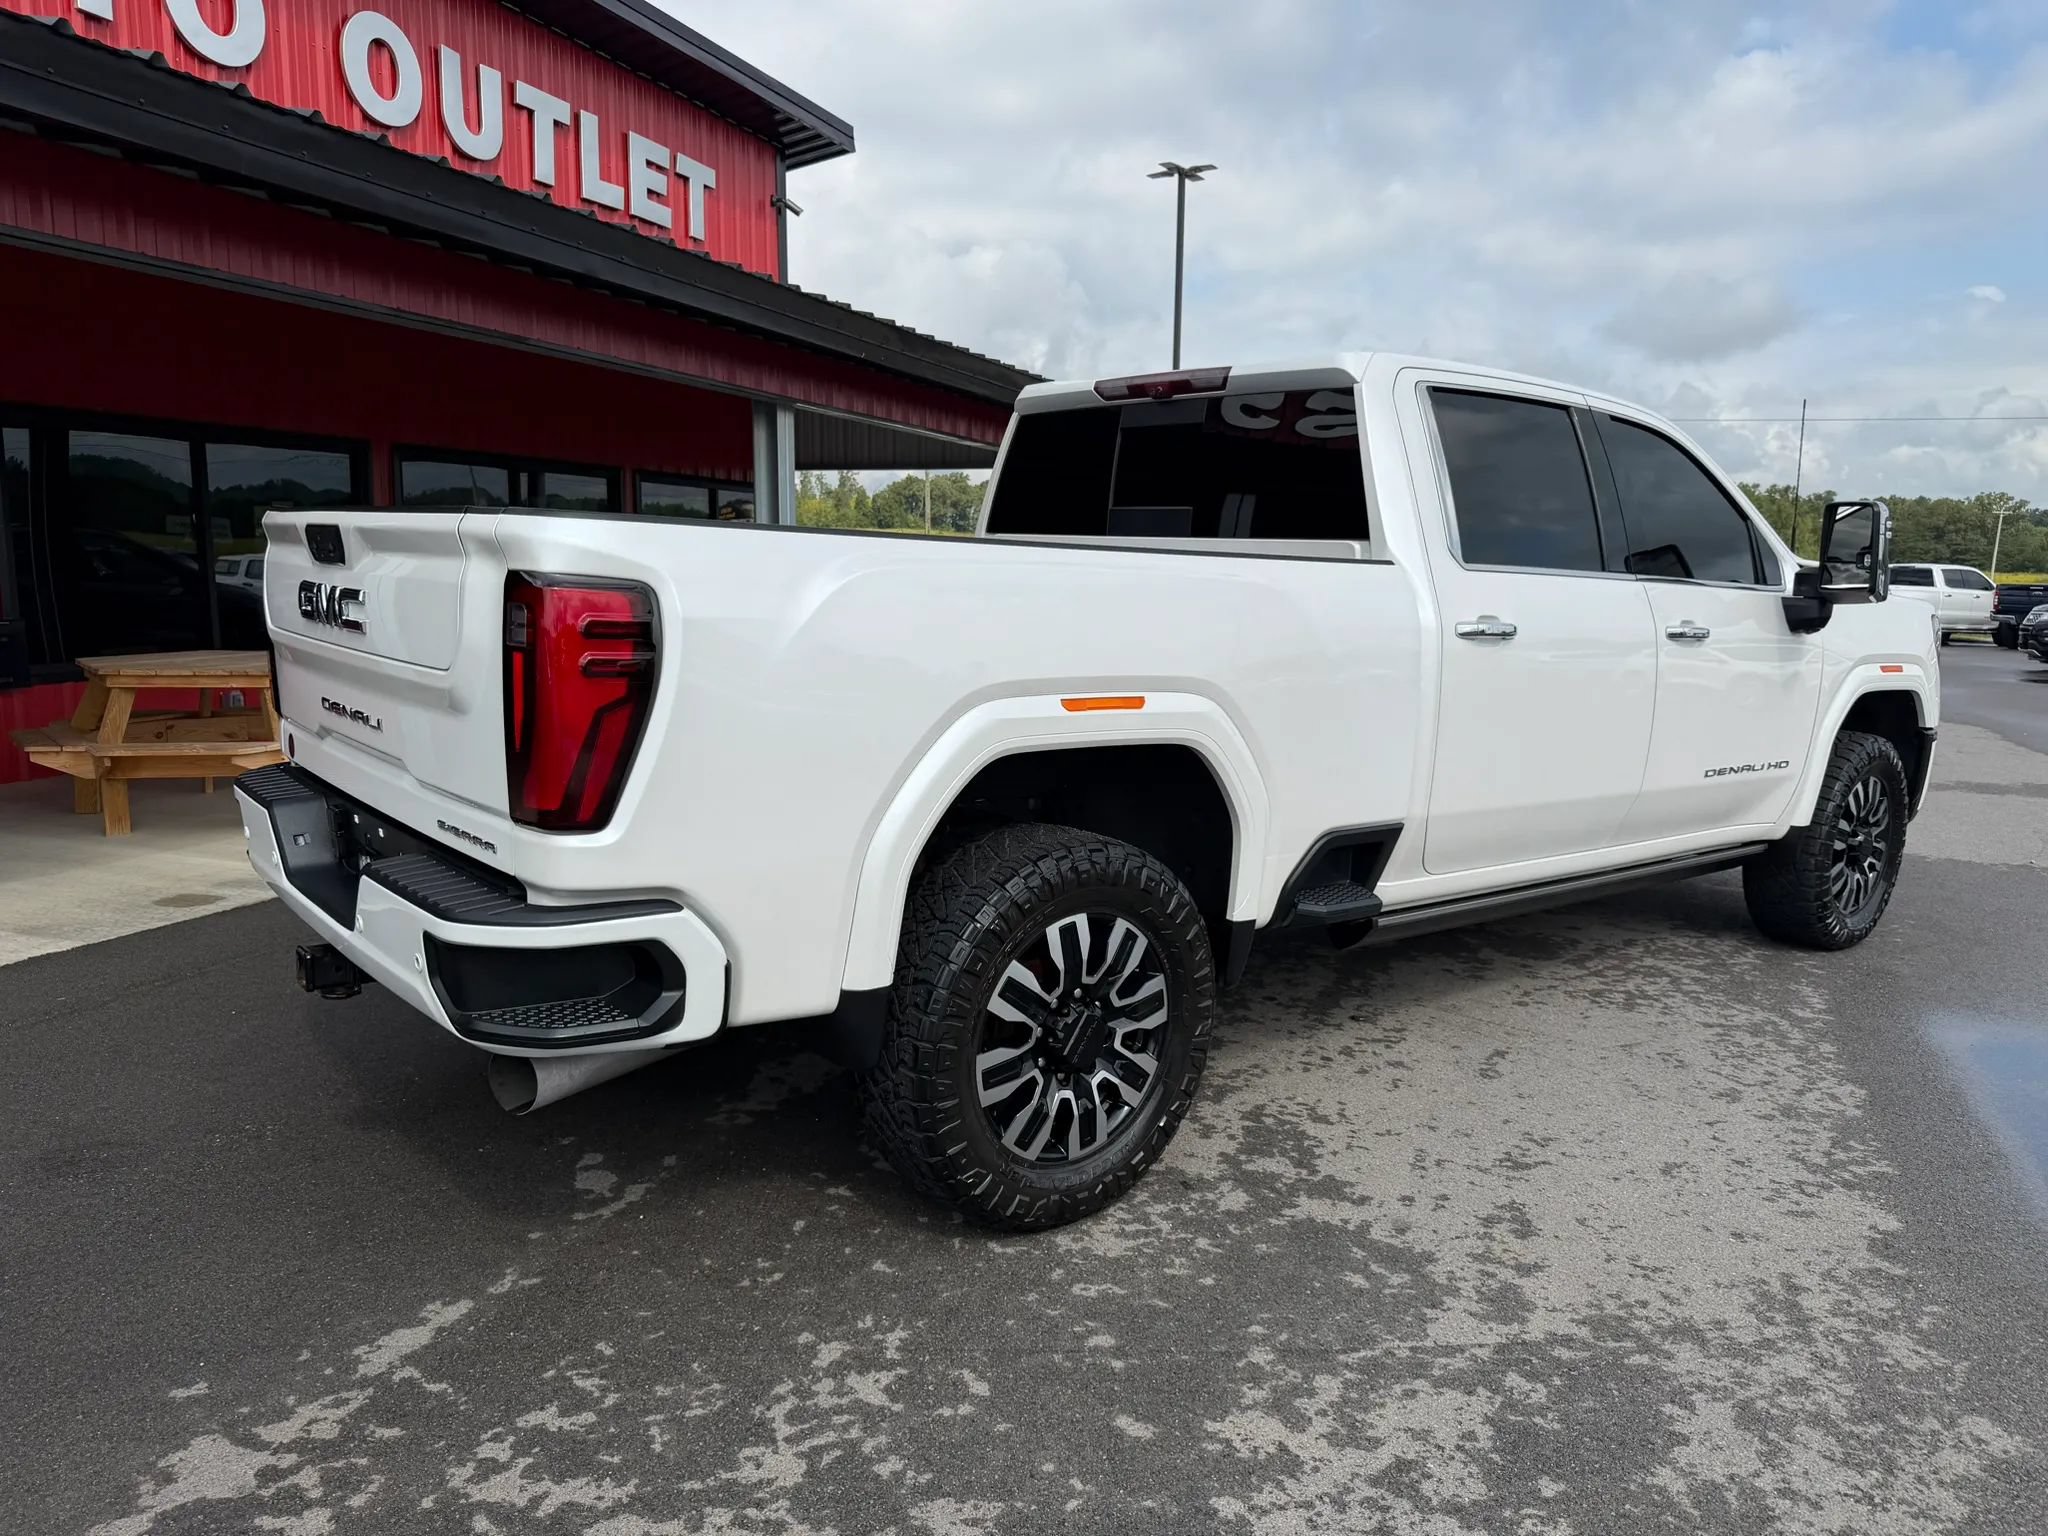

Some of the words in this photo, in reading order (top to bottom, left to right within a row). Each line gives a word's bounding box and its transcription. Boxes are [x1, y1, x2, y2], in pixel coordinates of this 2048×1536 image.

[341, 10, 716, 241] OUTLET
[298, 579, 368, 636] GMC
[321, 696, 384, 733] DENALI
[1704, 763, 1765, 778] DENALI
[1766, 760, 1790, 771] HD
[436, 819, 498, 855] SIERRA
